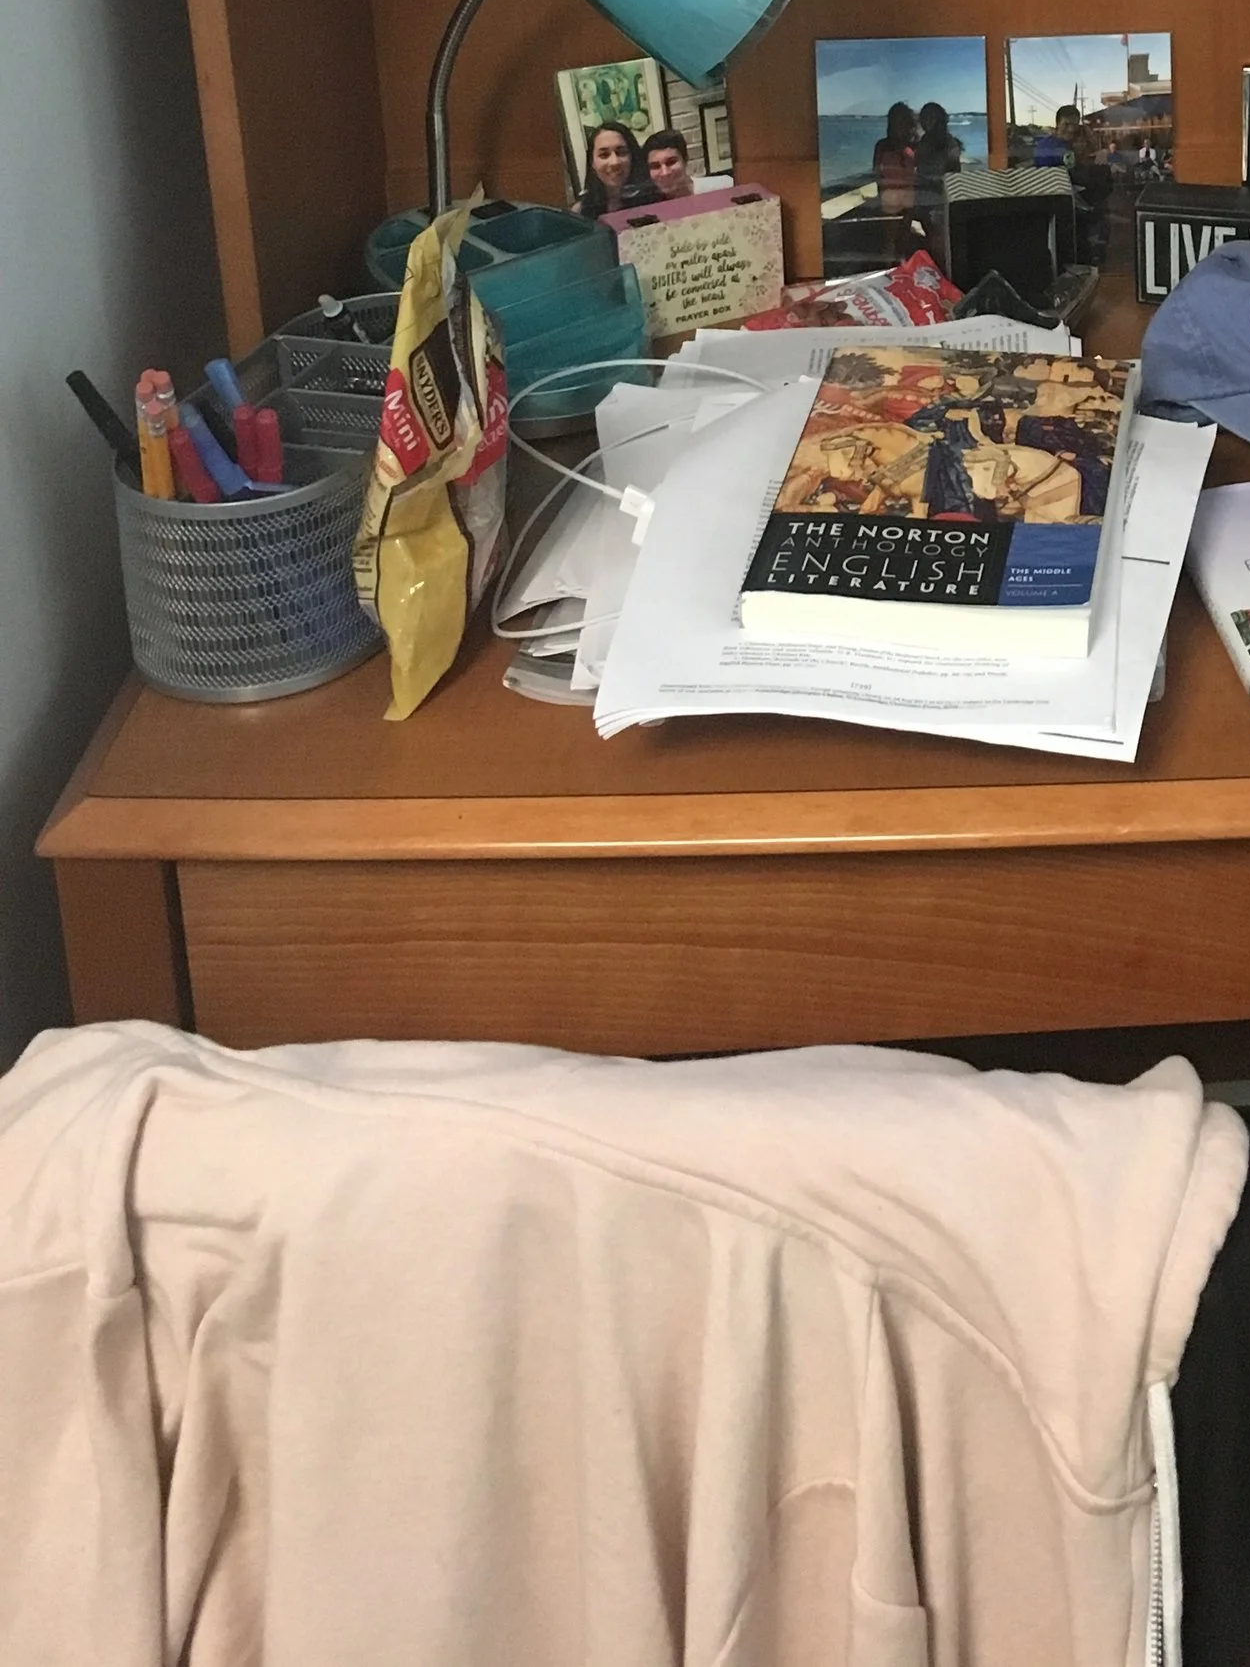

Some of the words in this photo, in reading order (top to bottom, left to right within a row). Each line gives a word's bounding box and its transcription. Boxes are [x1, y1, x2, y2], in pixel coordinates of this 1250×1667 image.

[651, 271, 687, 290] SISTERS
[691, 264, 712, 281] will
[717, 259, 752, 273] always
[665, 288, 678, 301] be
[681, 275, 727, 295] connected
[675, 310, 709, 323] PRAYER
[713, 305, 731, 315] BOX
[683, 297, 697, 309] the
[415, 351, 448, 440] SNYDER'S
[385, 389, 420, 451] Mini
[788, 521, 844, 537] THE
[858, 524, 990, 545] NORTON
[778, 536, 989, 559] ANTHOLOGY
[771, 551, 985, 583] ENGLISH
[1010, 567, 1029, 575] THE
[1033, 567, 1072, 576] MIDDLE
[767, 573, 981, 596] LITERATURE
[1008, 575, 1034, 583] AGES
[1005, 588, 1048, 597] VOLUME
